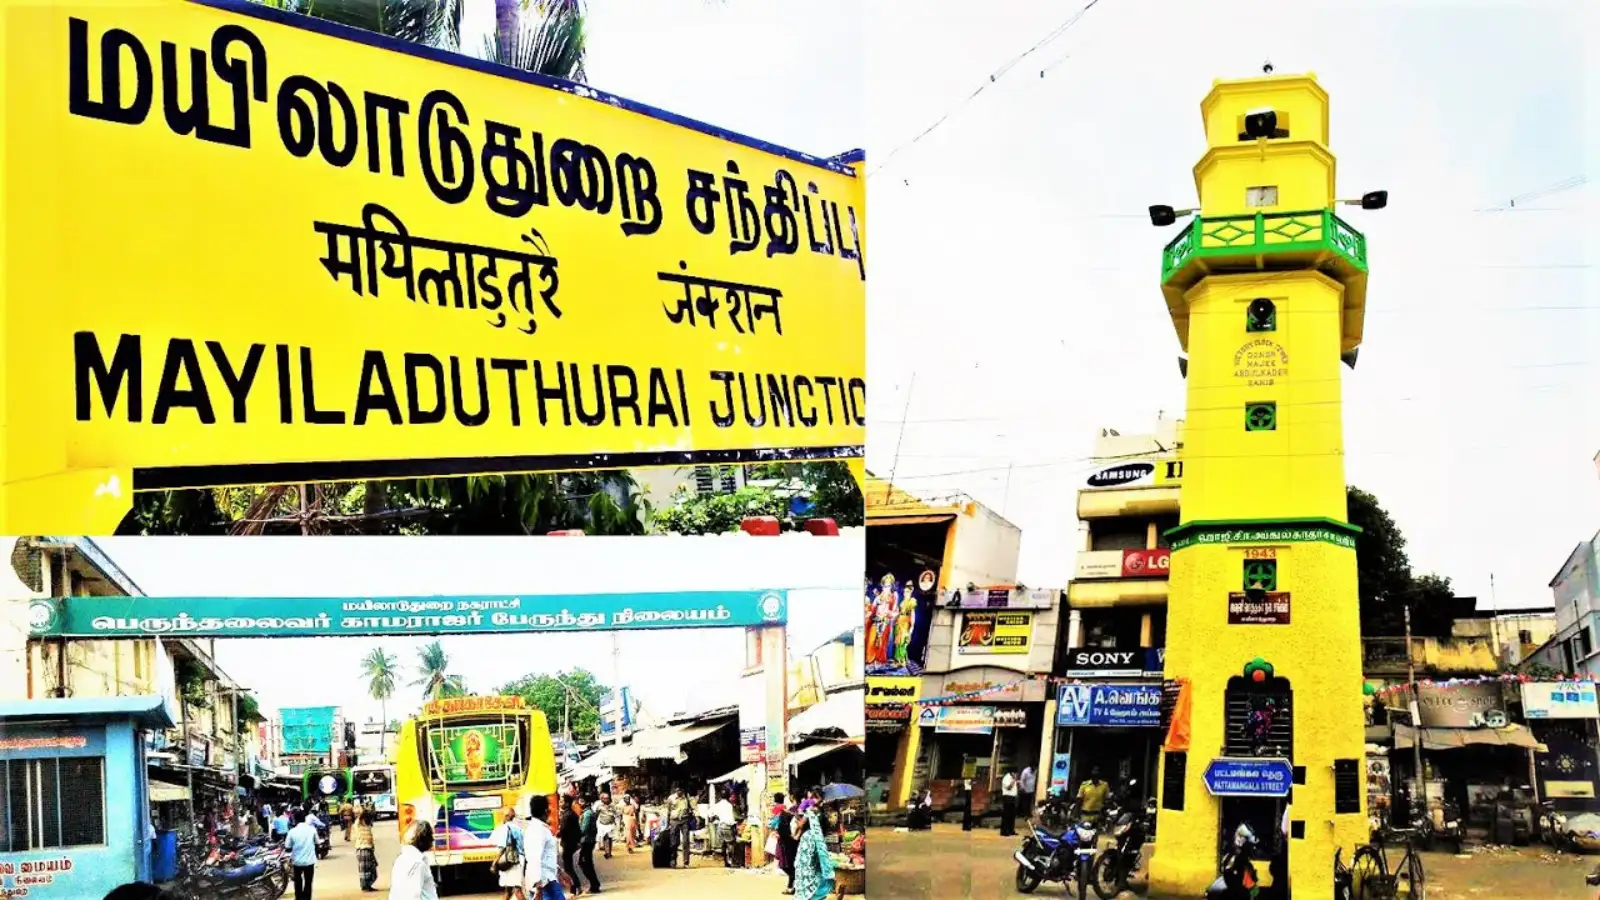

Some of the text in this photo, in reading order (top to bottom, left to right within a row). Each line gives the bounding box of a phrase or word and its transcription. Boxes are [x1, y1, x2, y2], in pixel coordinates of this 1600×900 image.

[69, 17, 866, 281] மயிலாடுதுறை சந்திப்பு
[314, 203, 562, 334] मयिलाडुतुरै
[74, 329, 690, 427] MAYILADUTHURAI
[1094, 468, 1147, 480] SAMSUNG
[1148, 555, 1170, 570] LG
[1244, 549, 1277, 559] 1943
[92, 605, 731, 632] பெருந்தலைவர் காமராஜர் பேருந்து நிலையம்
[1076, 653, 1135, 665] SONY
